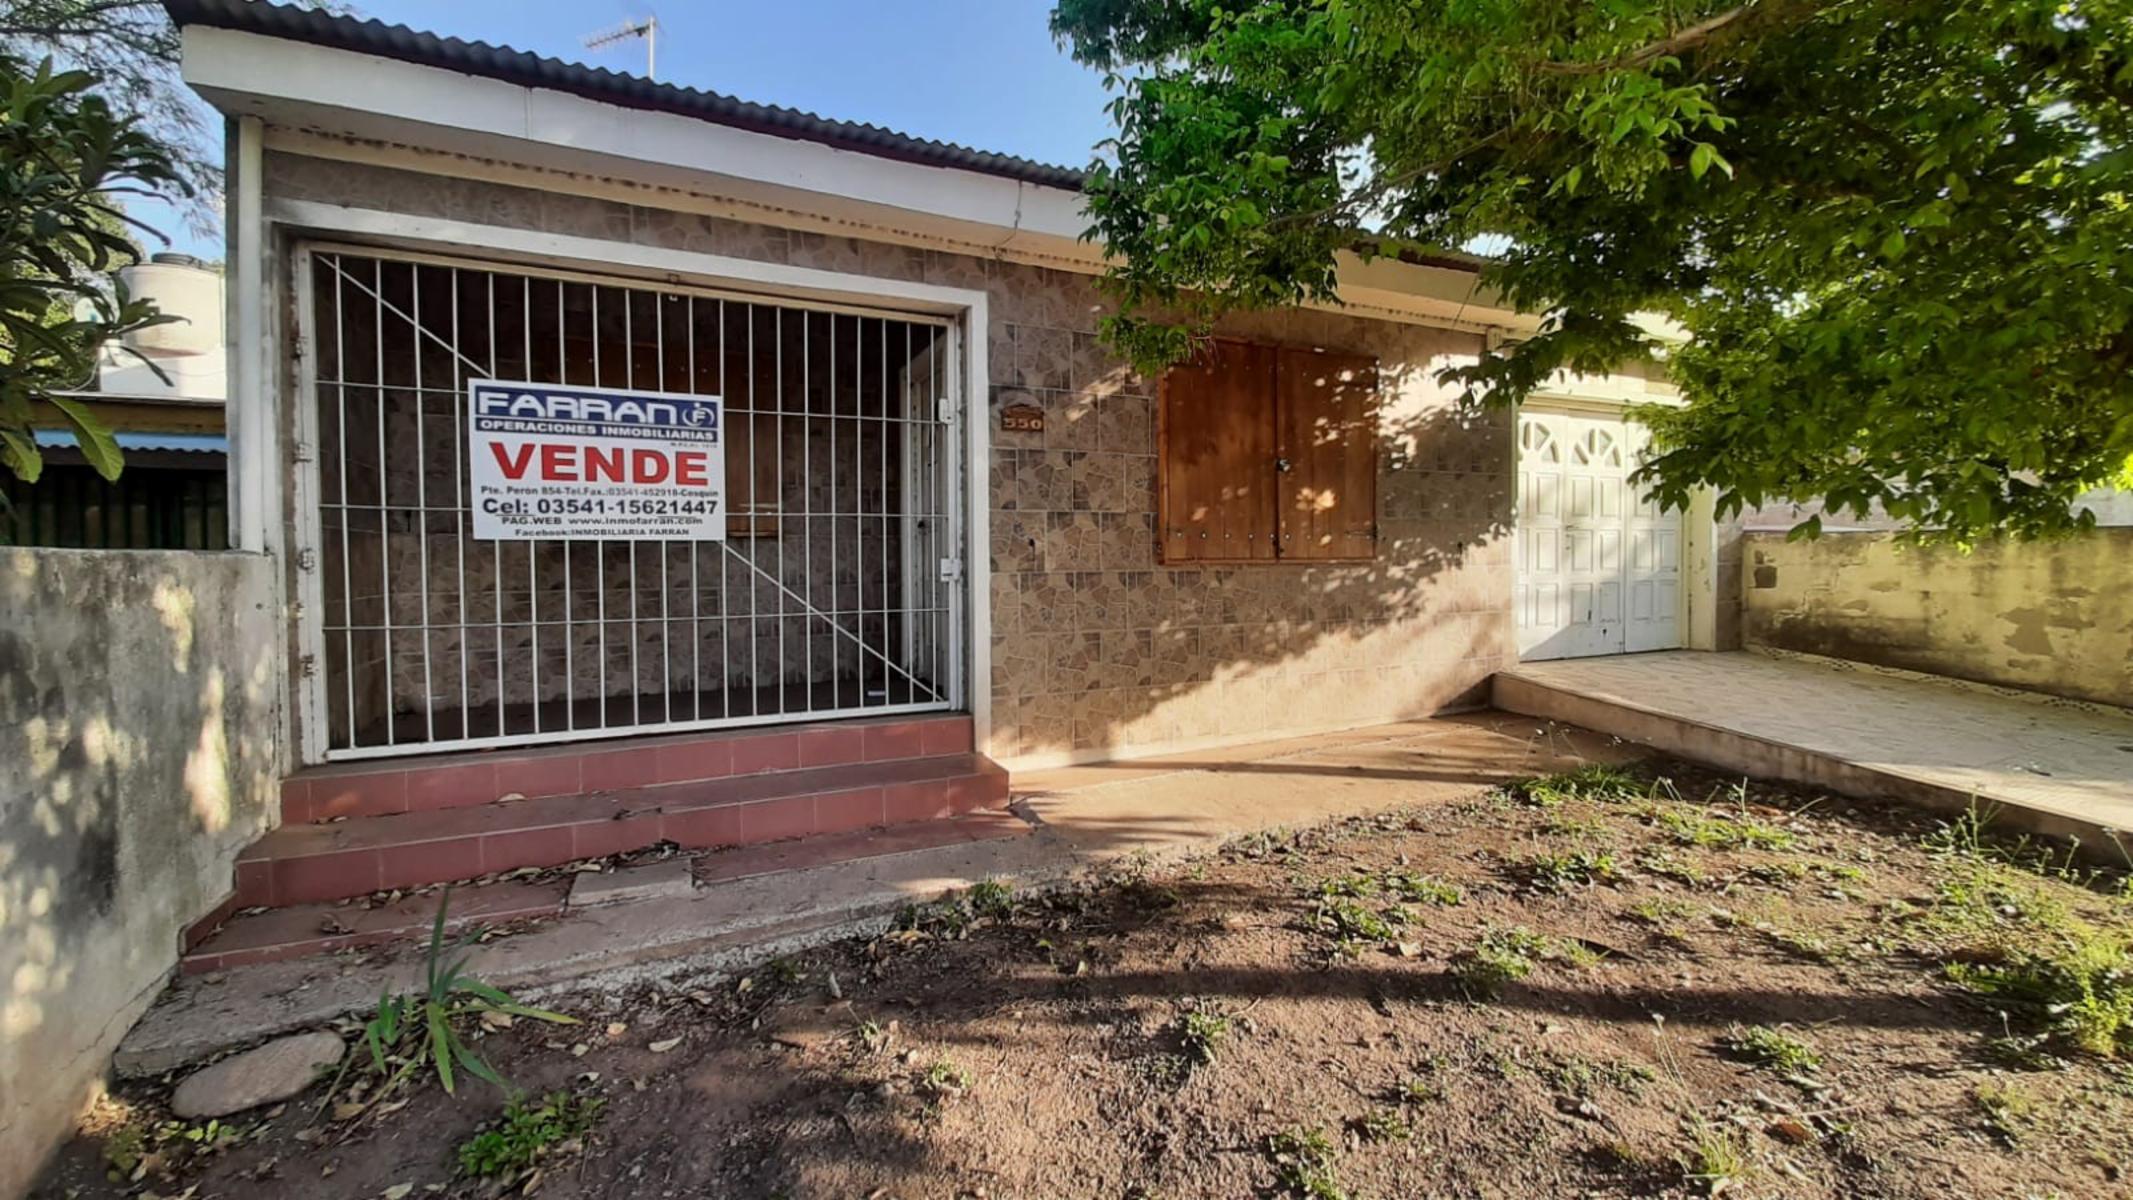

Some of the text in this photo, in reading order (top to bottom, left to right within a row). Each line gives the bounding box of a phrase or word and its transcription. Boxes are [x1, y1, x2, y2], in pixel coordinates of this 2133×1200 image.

[481, 420, 713, 440] OPERACIONES INMOBILIARIAS
[488, 442, 708, 486] VENDE
[481, 486, 503, 494] Pte.
[482, 498, 718, 514] Cel: 03541-15621447
[568, 517, 702, 525] www.inmofarran.com
